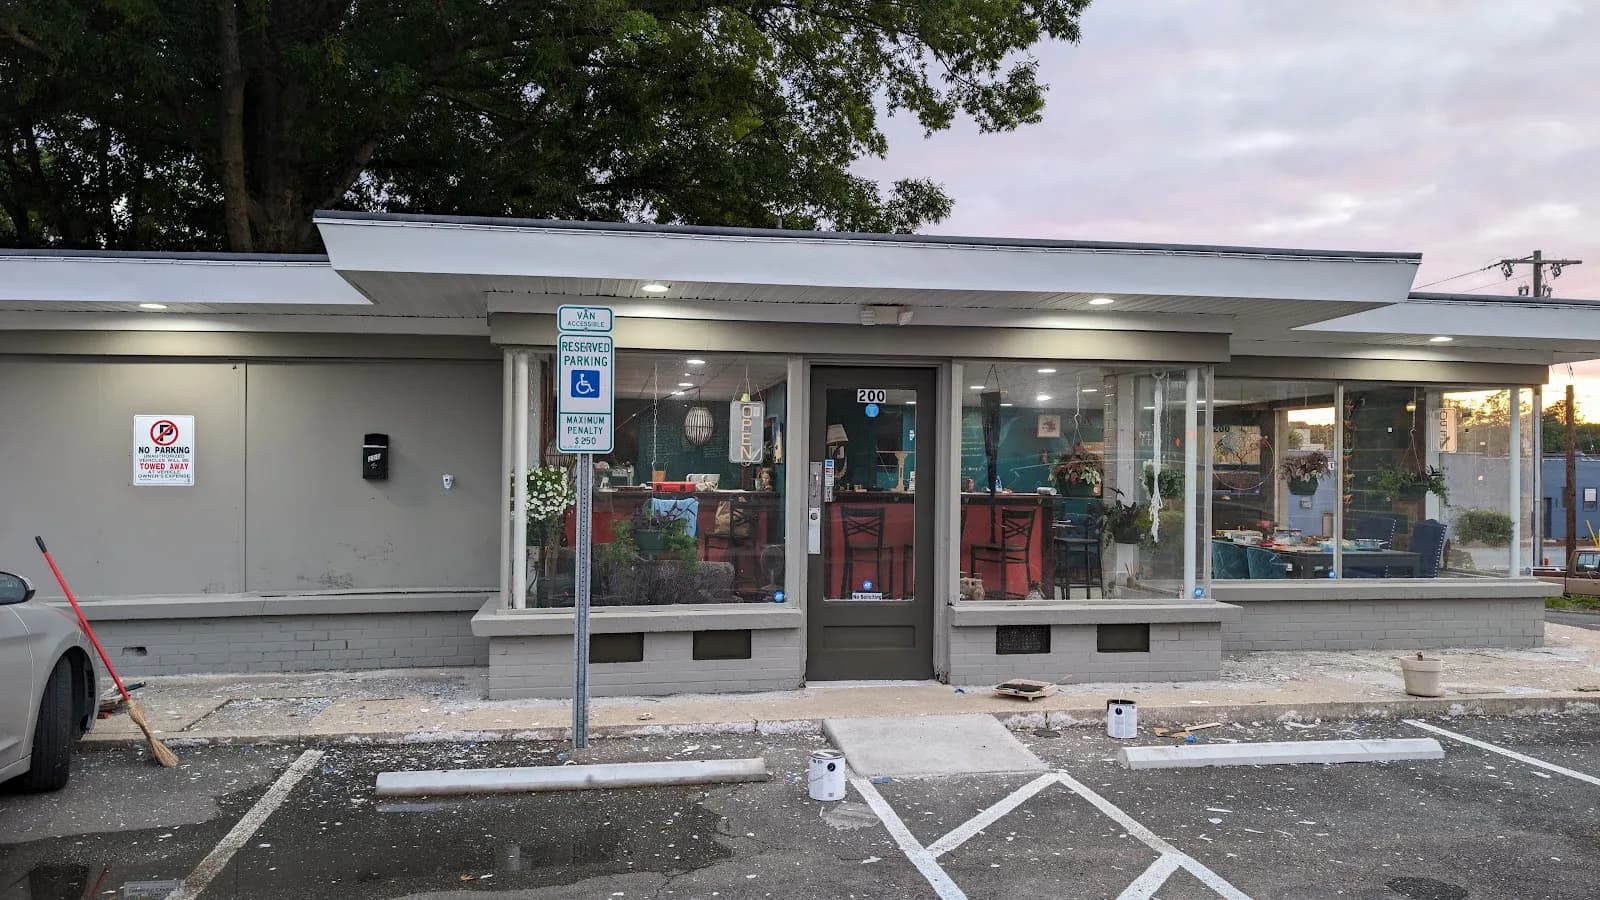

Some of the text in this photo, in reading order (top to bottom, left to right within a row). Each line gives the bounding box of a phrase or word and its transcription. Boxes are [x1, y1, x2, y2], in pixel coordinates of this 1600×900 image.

[577, 312, 595, 320] VAN
[562, 342, 610, 353] RESERVED
[564, 356, 608, 367] PARKING
[859, 390, 885, 402] 200
[566, 416, 605, 425] MAXIMUM
[567, 426, 603, 435] PENALTY
[741, 405, 753, 461] OPEN
[138, 446, 190, 454] NO PARKING
